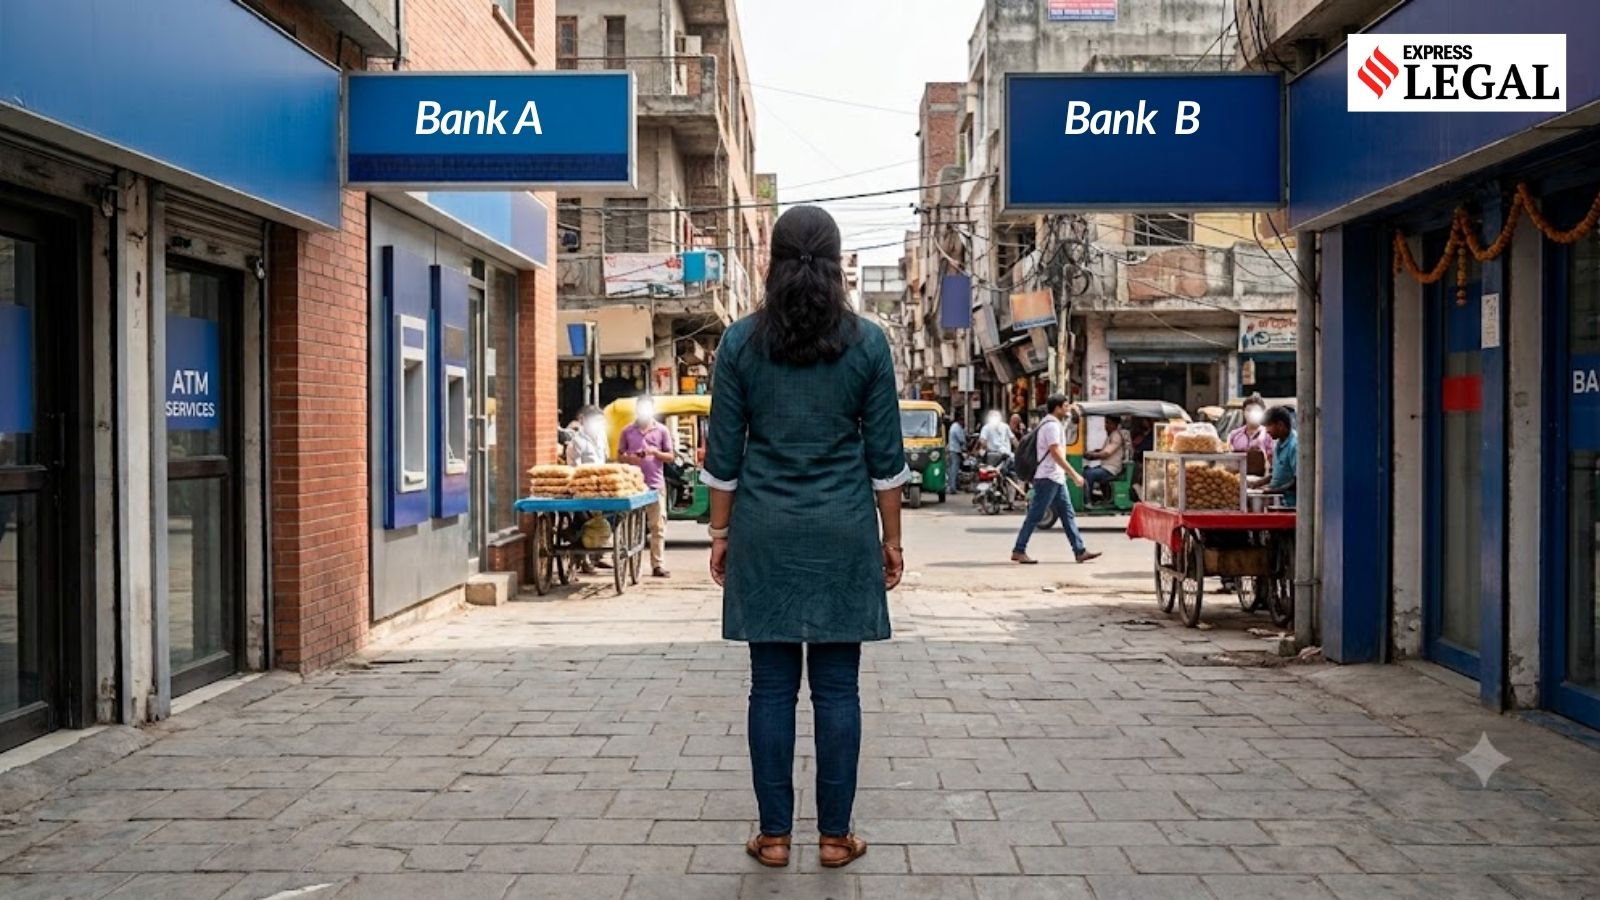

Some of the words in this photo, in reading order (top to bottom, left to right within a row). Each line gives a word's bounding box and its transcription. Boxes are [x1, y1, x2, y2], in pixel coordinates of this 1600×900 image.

[415, 99, 509, 135] Bank
[512, 100, 543, 135] A
[1064, 99, 1159, 135] Bank
[1174, 100, 1201, 135] B
[171, 369, 209, 396] ATM
[164, 400, 216, 418] SERVICES
